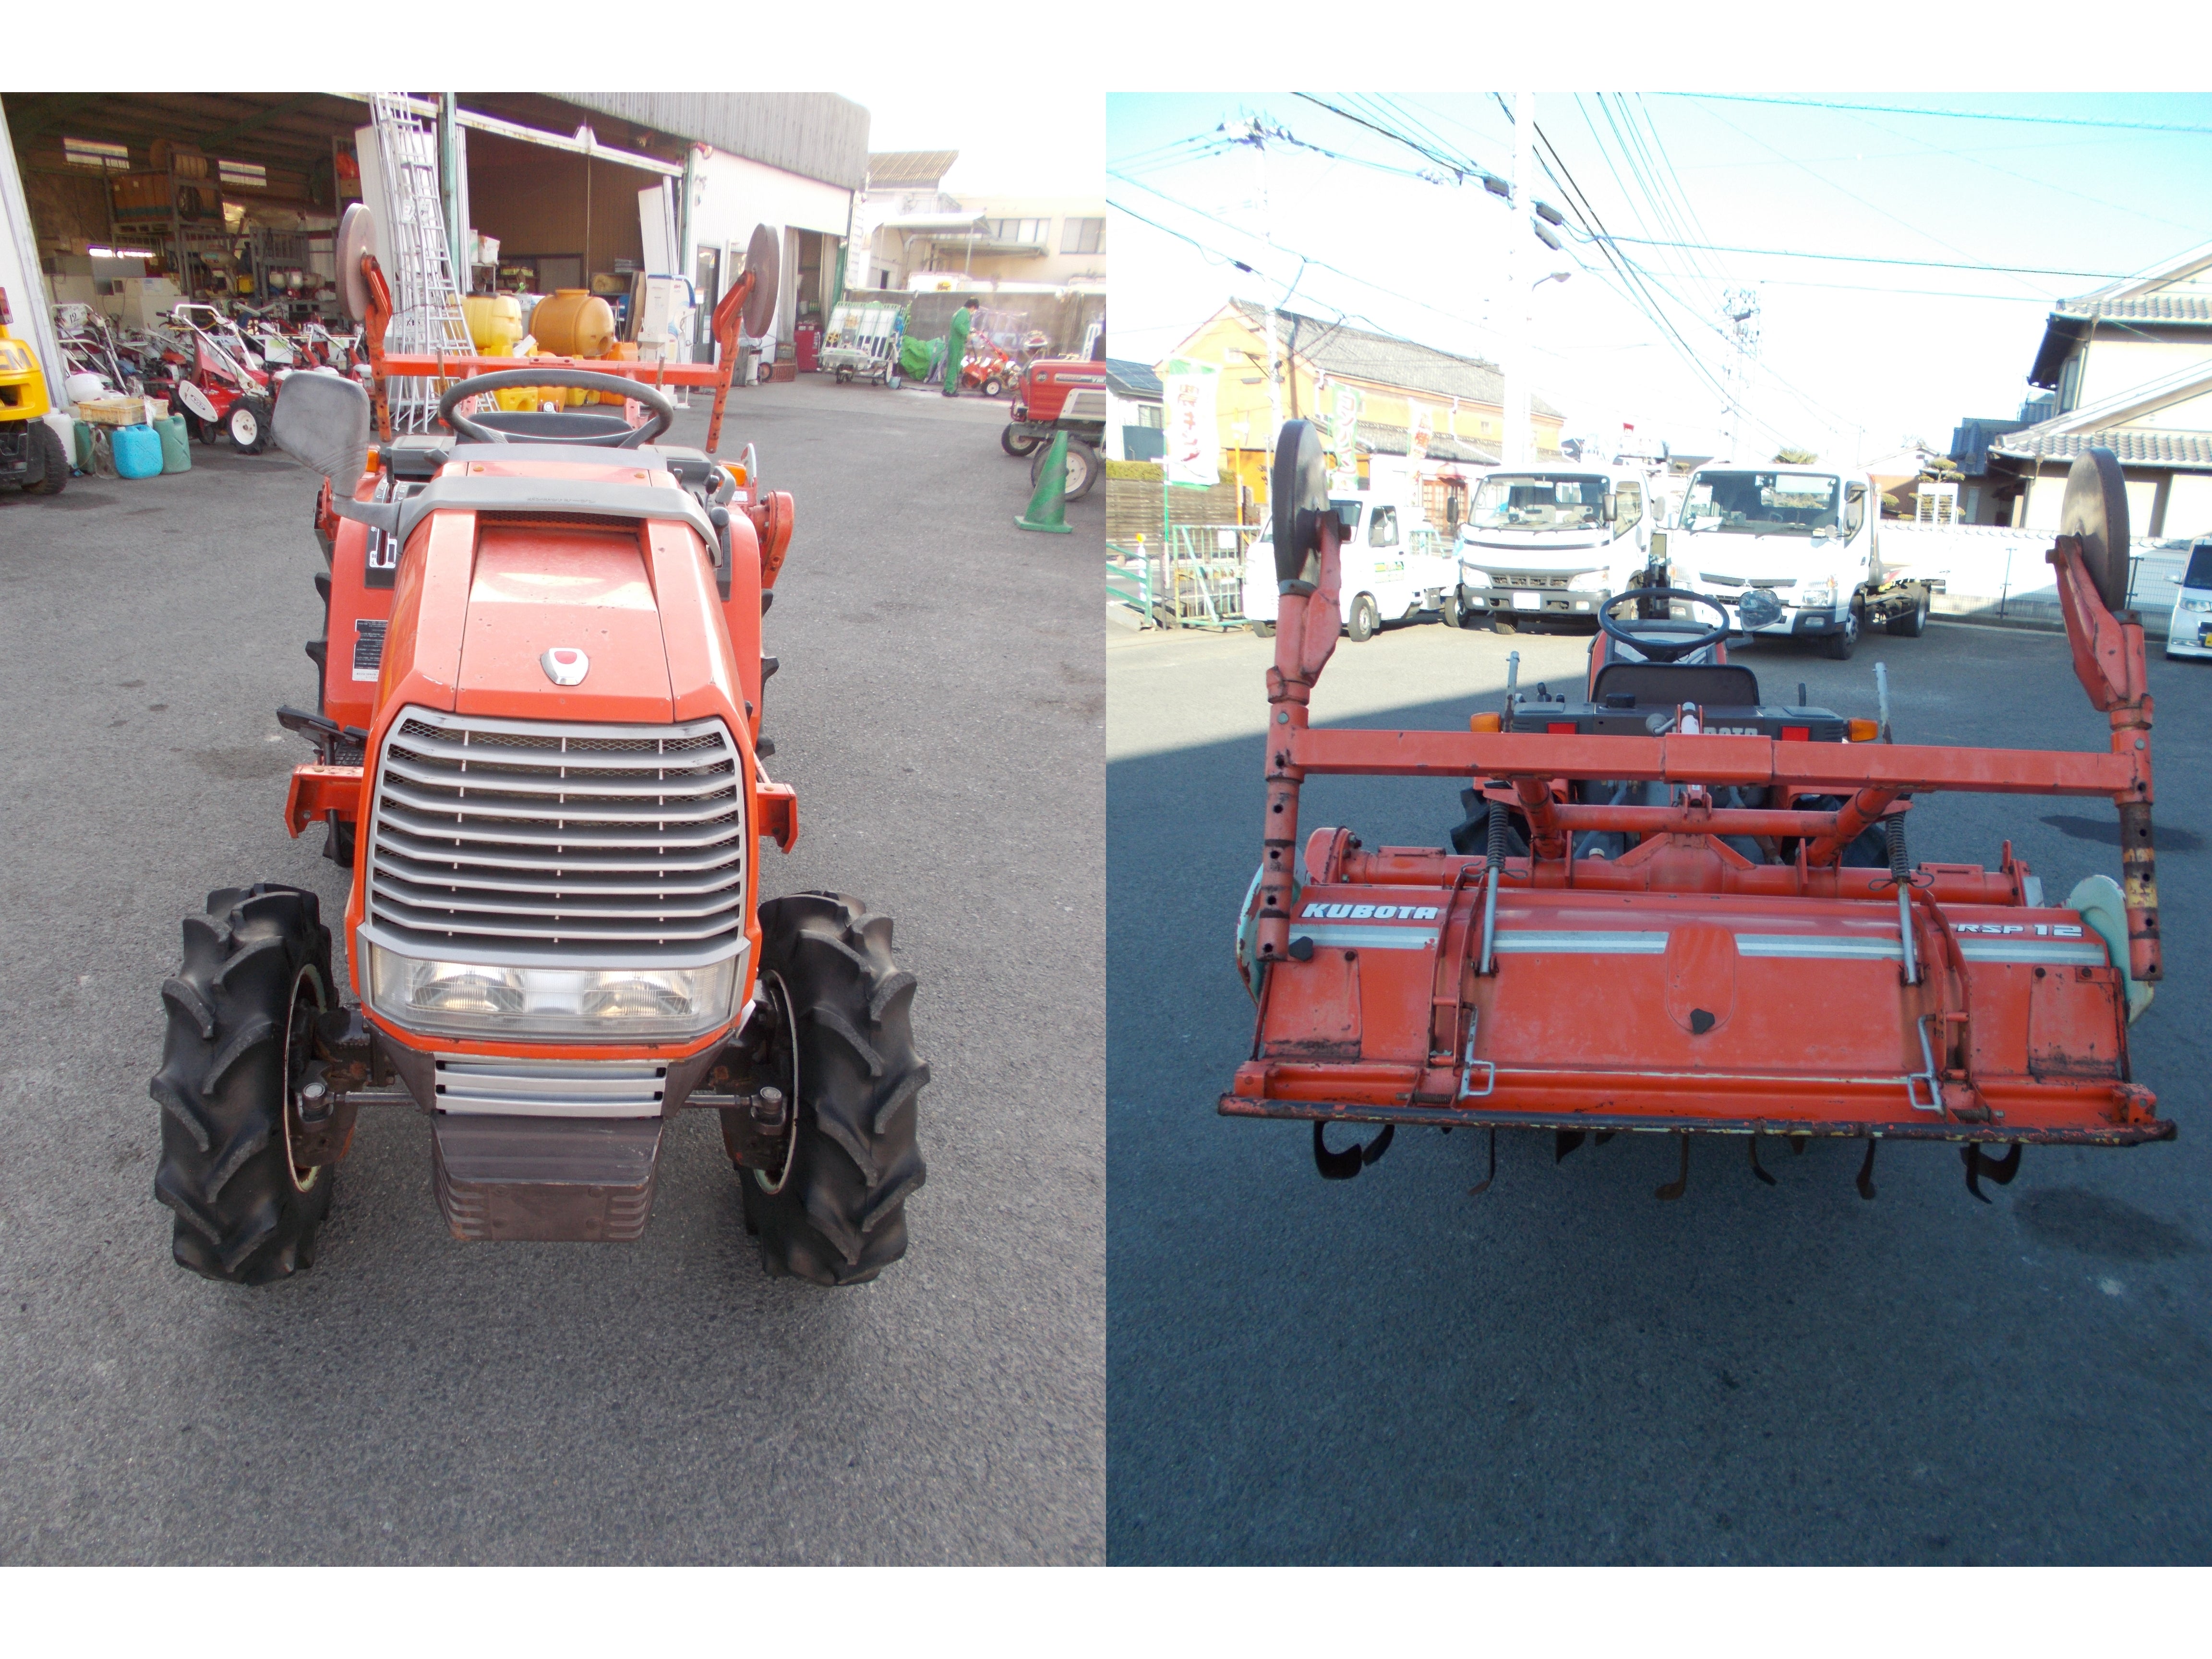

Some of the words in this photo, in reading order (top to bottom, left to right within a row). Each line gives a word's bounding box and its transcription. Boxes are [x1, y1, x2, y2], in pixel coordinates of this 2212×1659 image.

[1300, 903, 1439, 919] KUBOTA
[1956, 924, 2024, 934] RSP
[2033, 924, 2082, 937] 12
